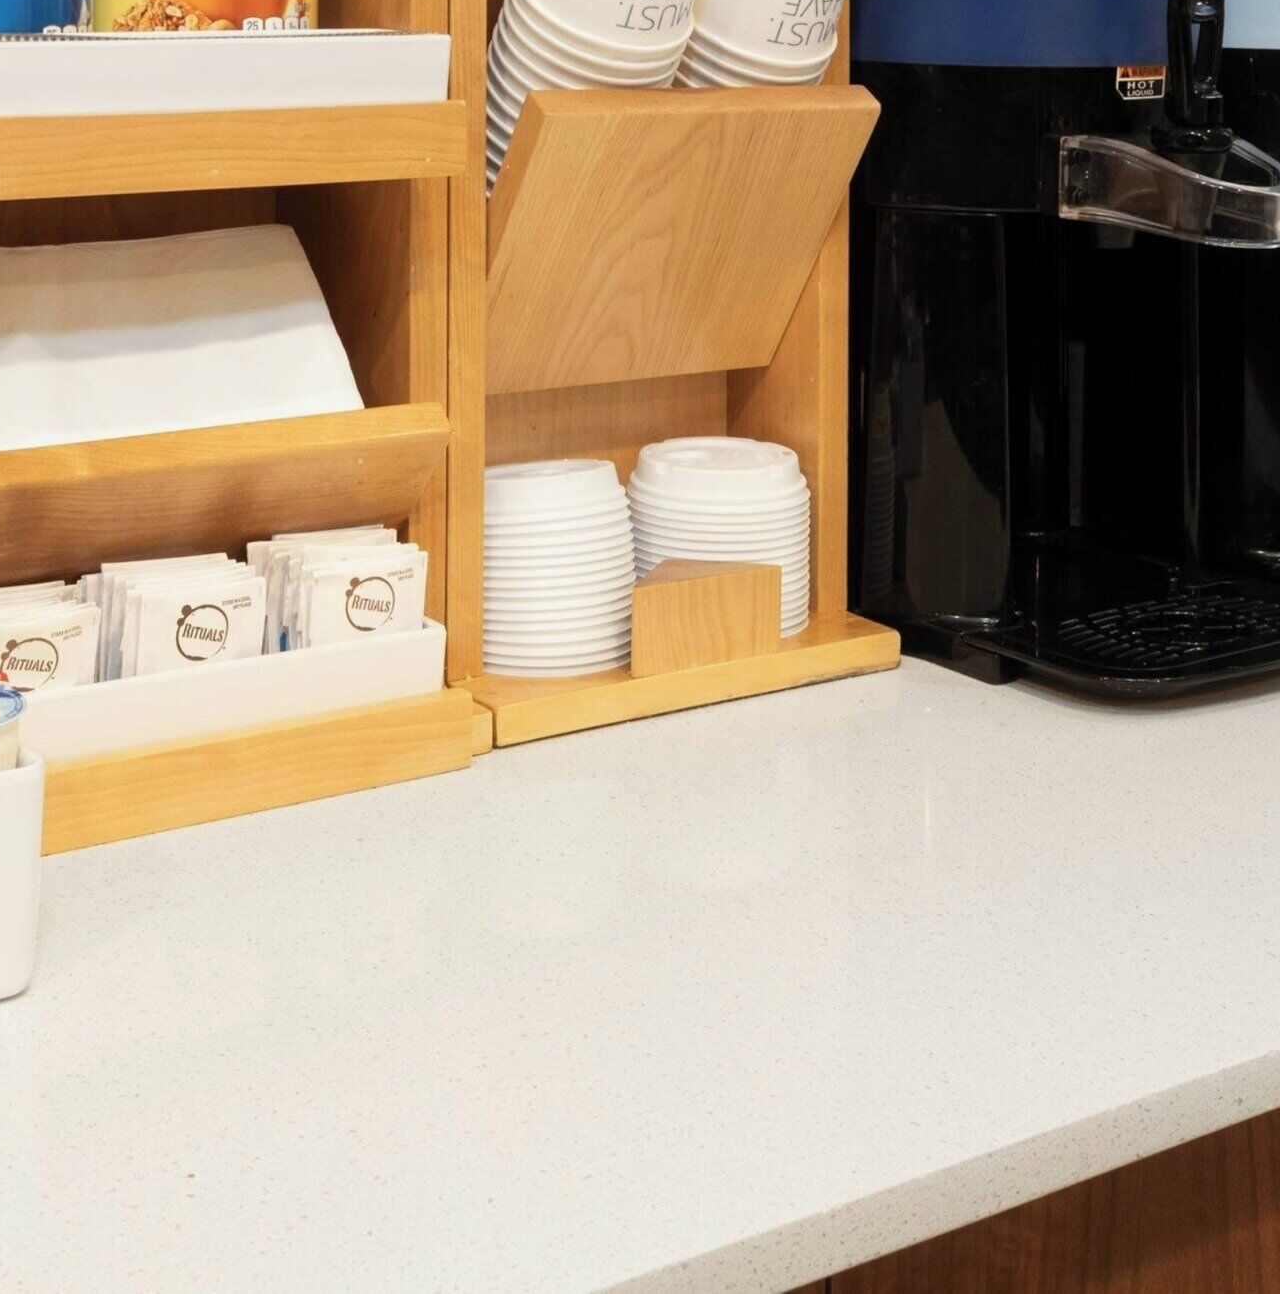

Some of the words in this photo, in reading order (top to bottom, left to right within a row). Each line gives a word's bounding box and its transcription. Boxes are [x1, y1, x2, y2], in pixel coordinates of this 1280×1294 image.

[616, 0, 690, 32] MUST.
[766, 16, 838, 47] MUST.
[1127, 81, 1155, 89] HOT
[351, 595, 391, 613] RITUALS
[182, 623, 225, 643] RITUALS
[6, 656, 54, 673] RITUALS
